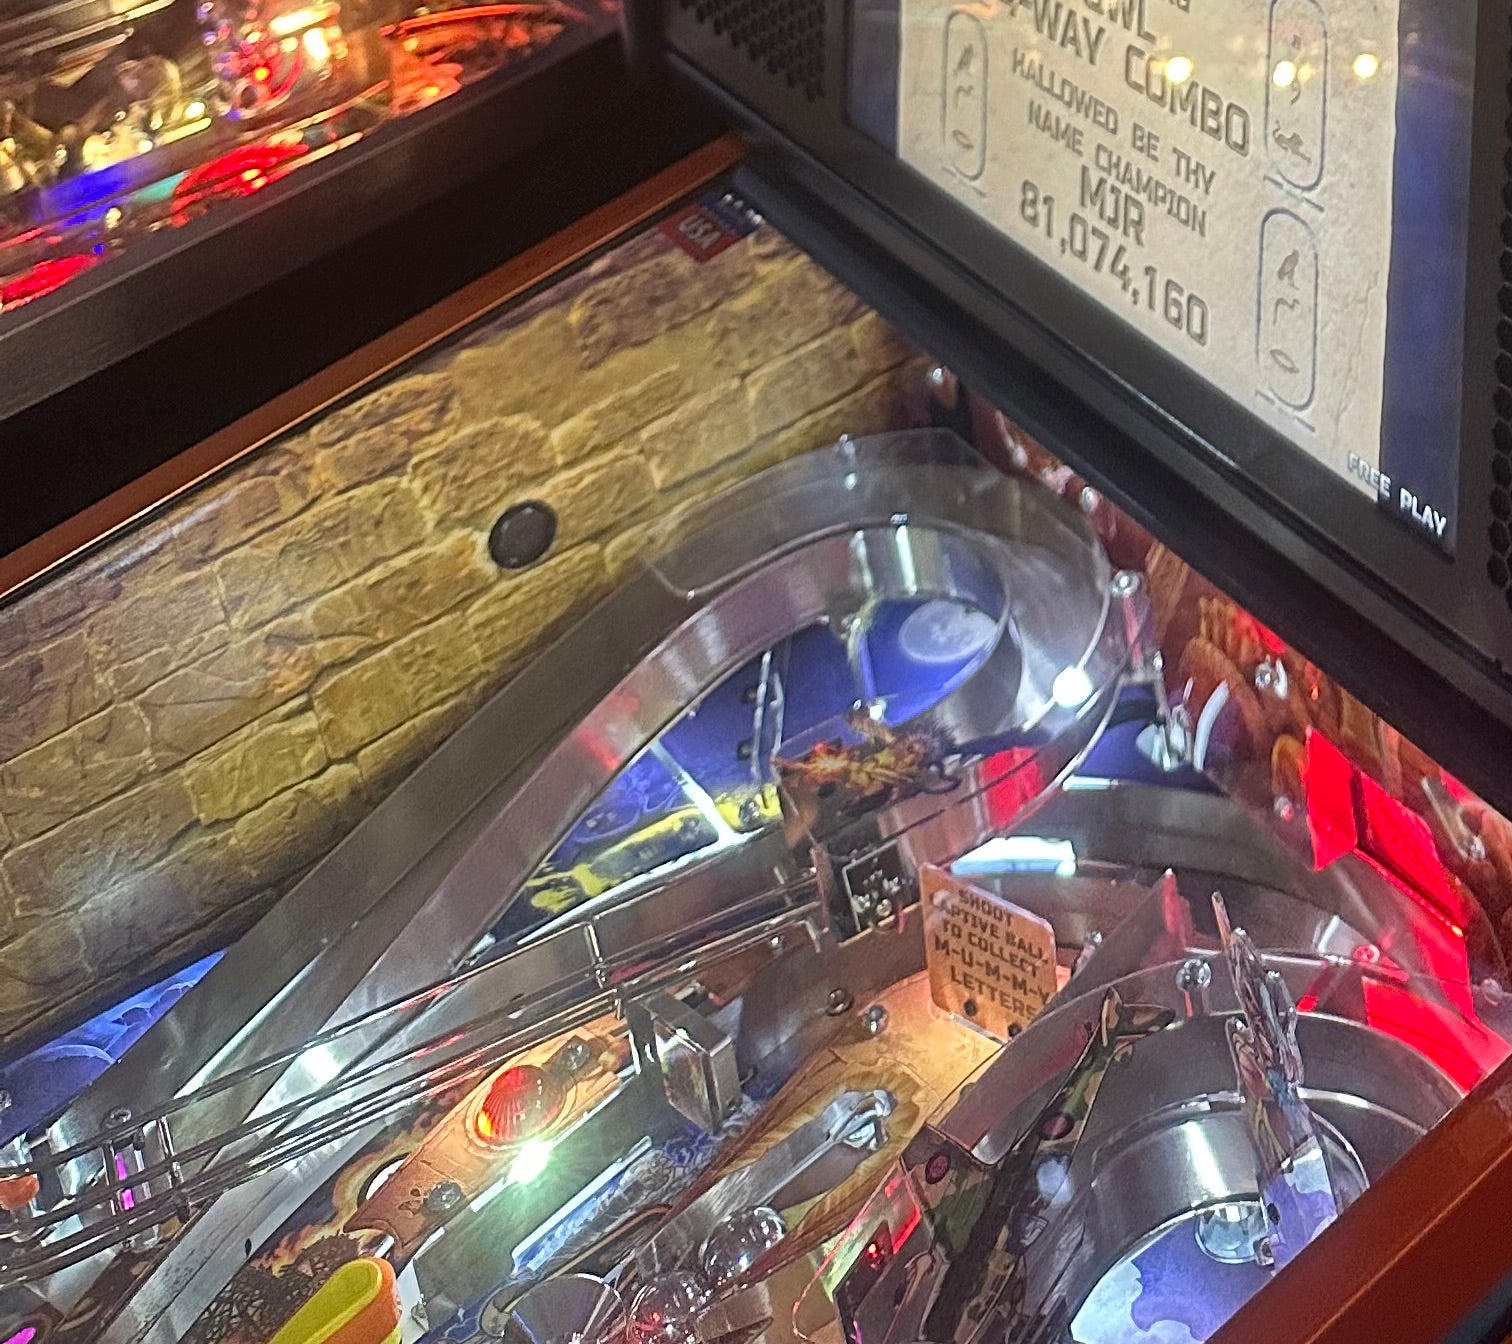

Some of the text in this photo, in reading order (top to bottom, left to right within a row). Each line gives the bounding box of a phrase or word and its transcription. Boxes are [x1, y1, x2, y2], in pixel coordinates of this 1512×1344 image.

[1012, 47, 1216, 196] HALLOWED BE THY
[1125, 43, 1250, 158] COMBO
[1029, 100, 1207, 238] NAME CHAMPION
[1080, 165, 1145, 247] MJR
[1020, 179, 1209, 347] 81,074,160
[1347, 451, 1447, 538] FREE PLAY
[943, 918, 1037, 979] TO COLLECT
[958, 889, 1013, 927] SHOOT
[934, 934, 1049, 1005] M-U-M-M-Y
